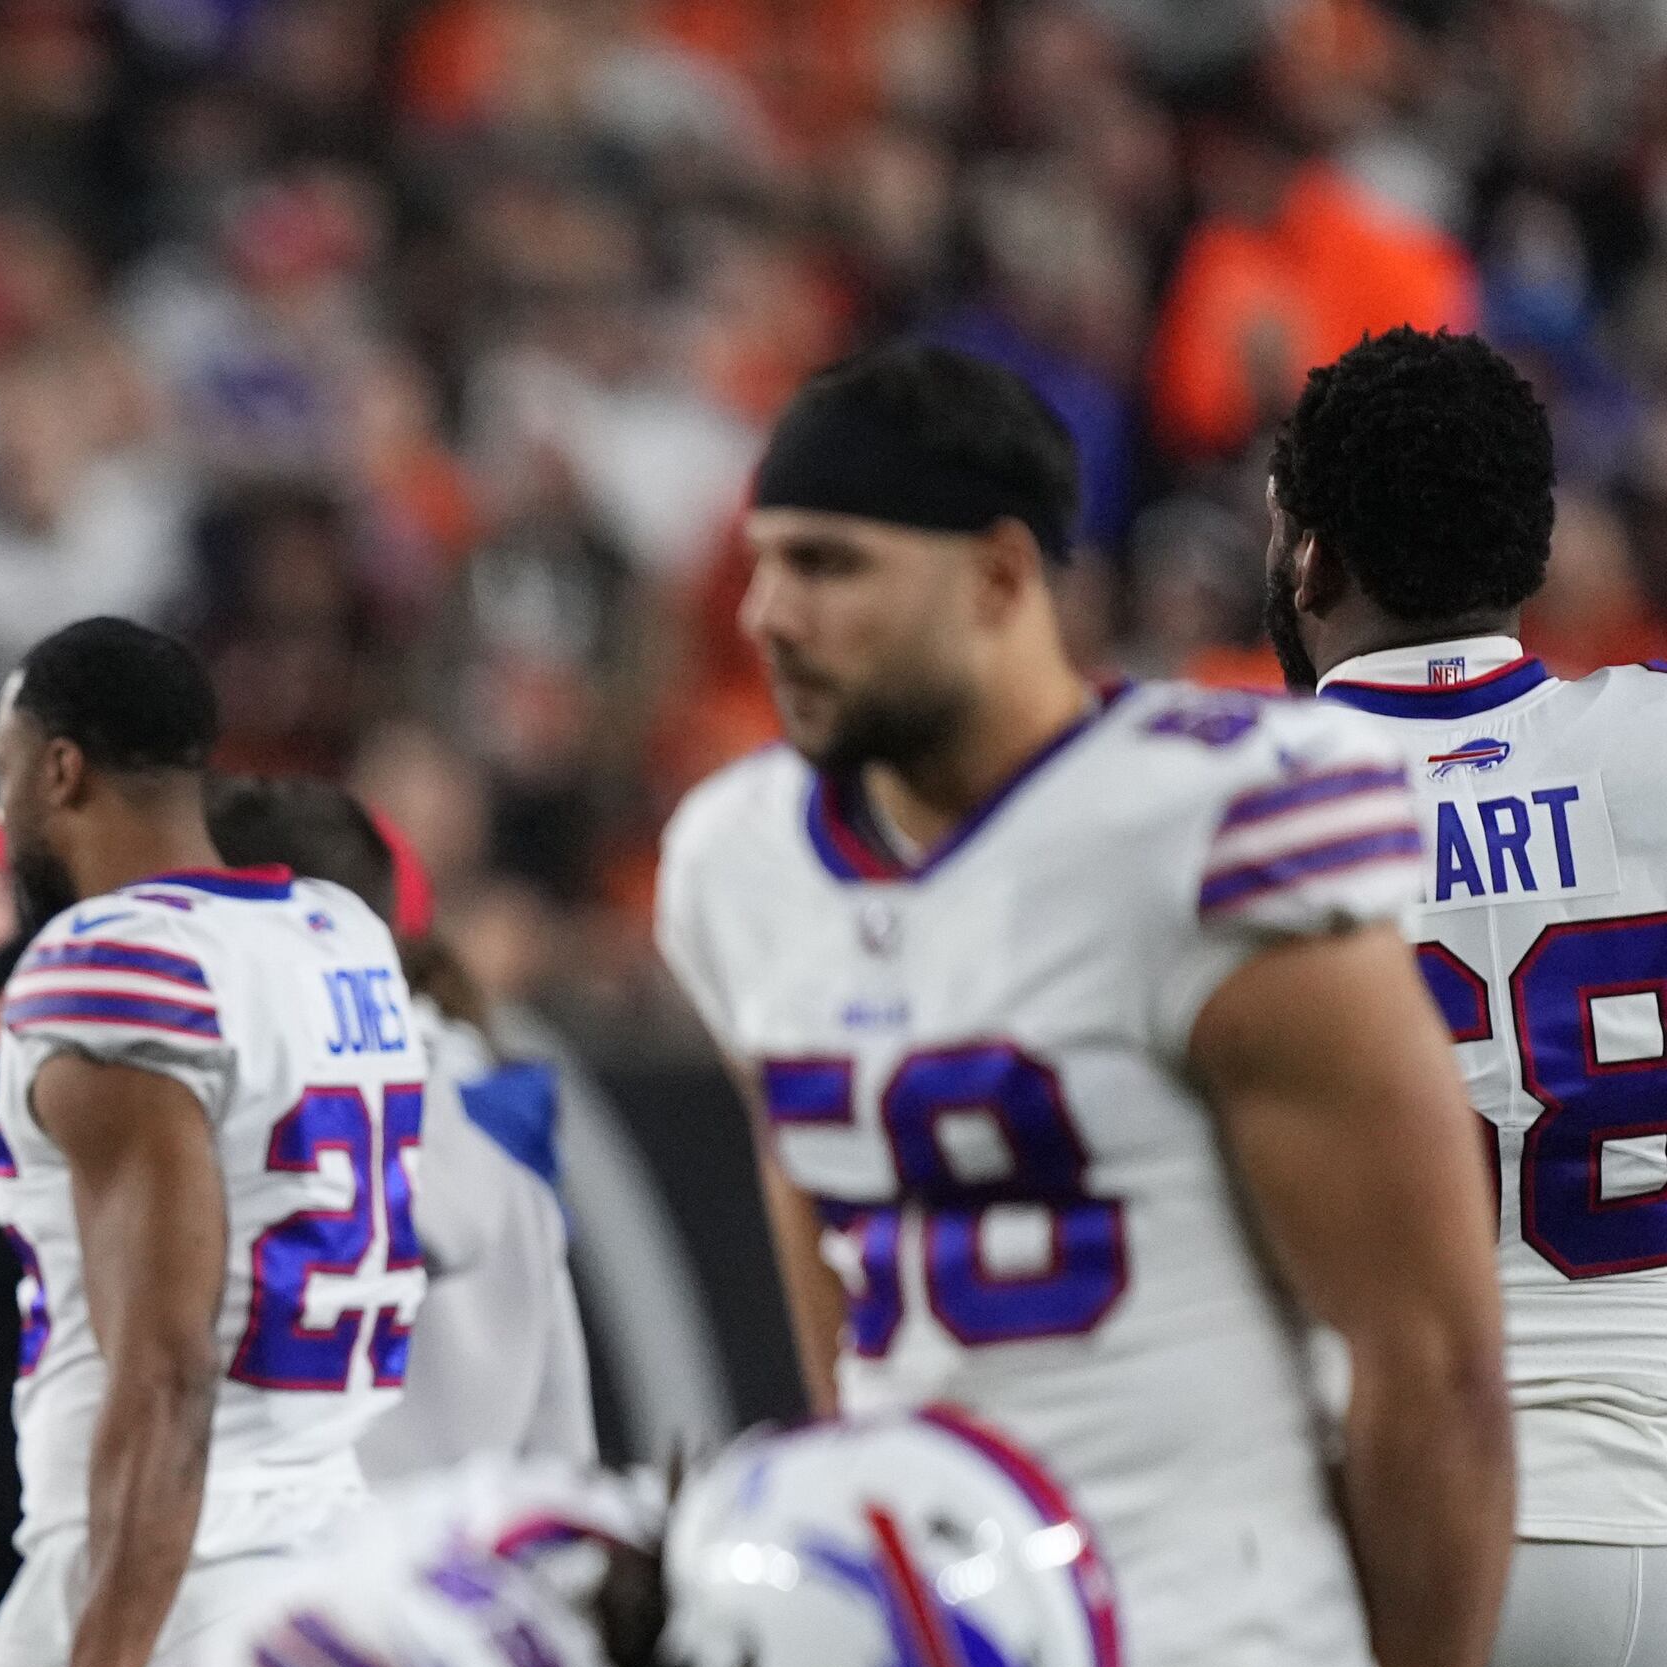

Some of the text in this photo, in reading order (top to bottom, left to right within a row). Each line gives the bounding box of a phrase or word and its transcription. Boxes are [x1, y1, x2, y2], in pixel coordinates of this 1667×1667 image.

[1433, 667, 1461, 686] NFL
[1435, 786, 1579, 902] ART
[763, 1040, 1128, 1358] 58
